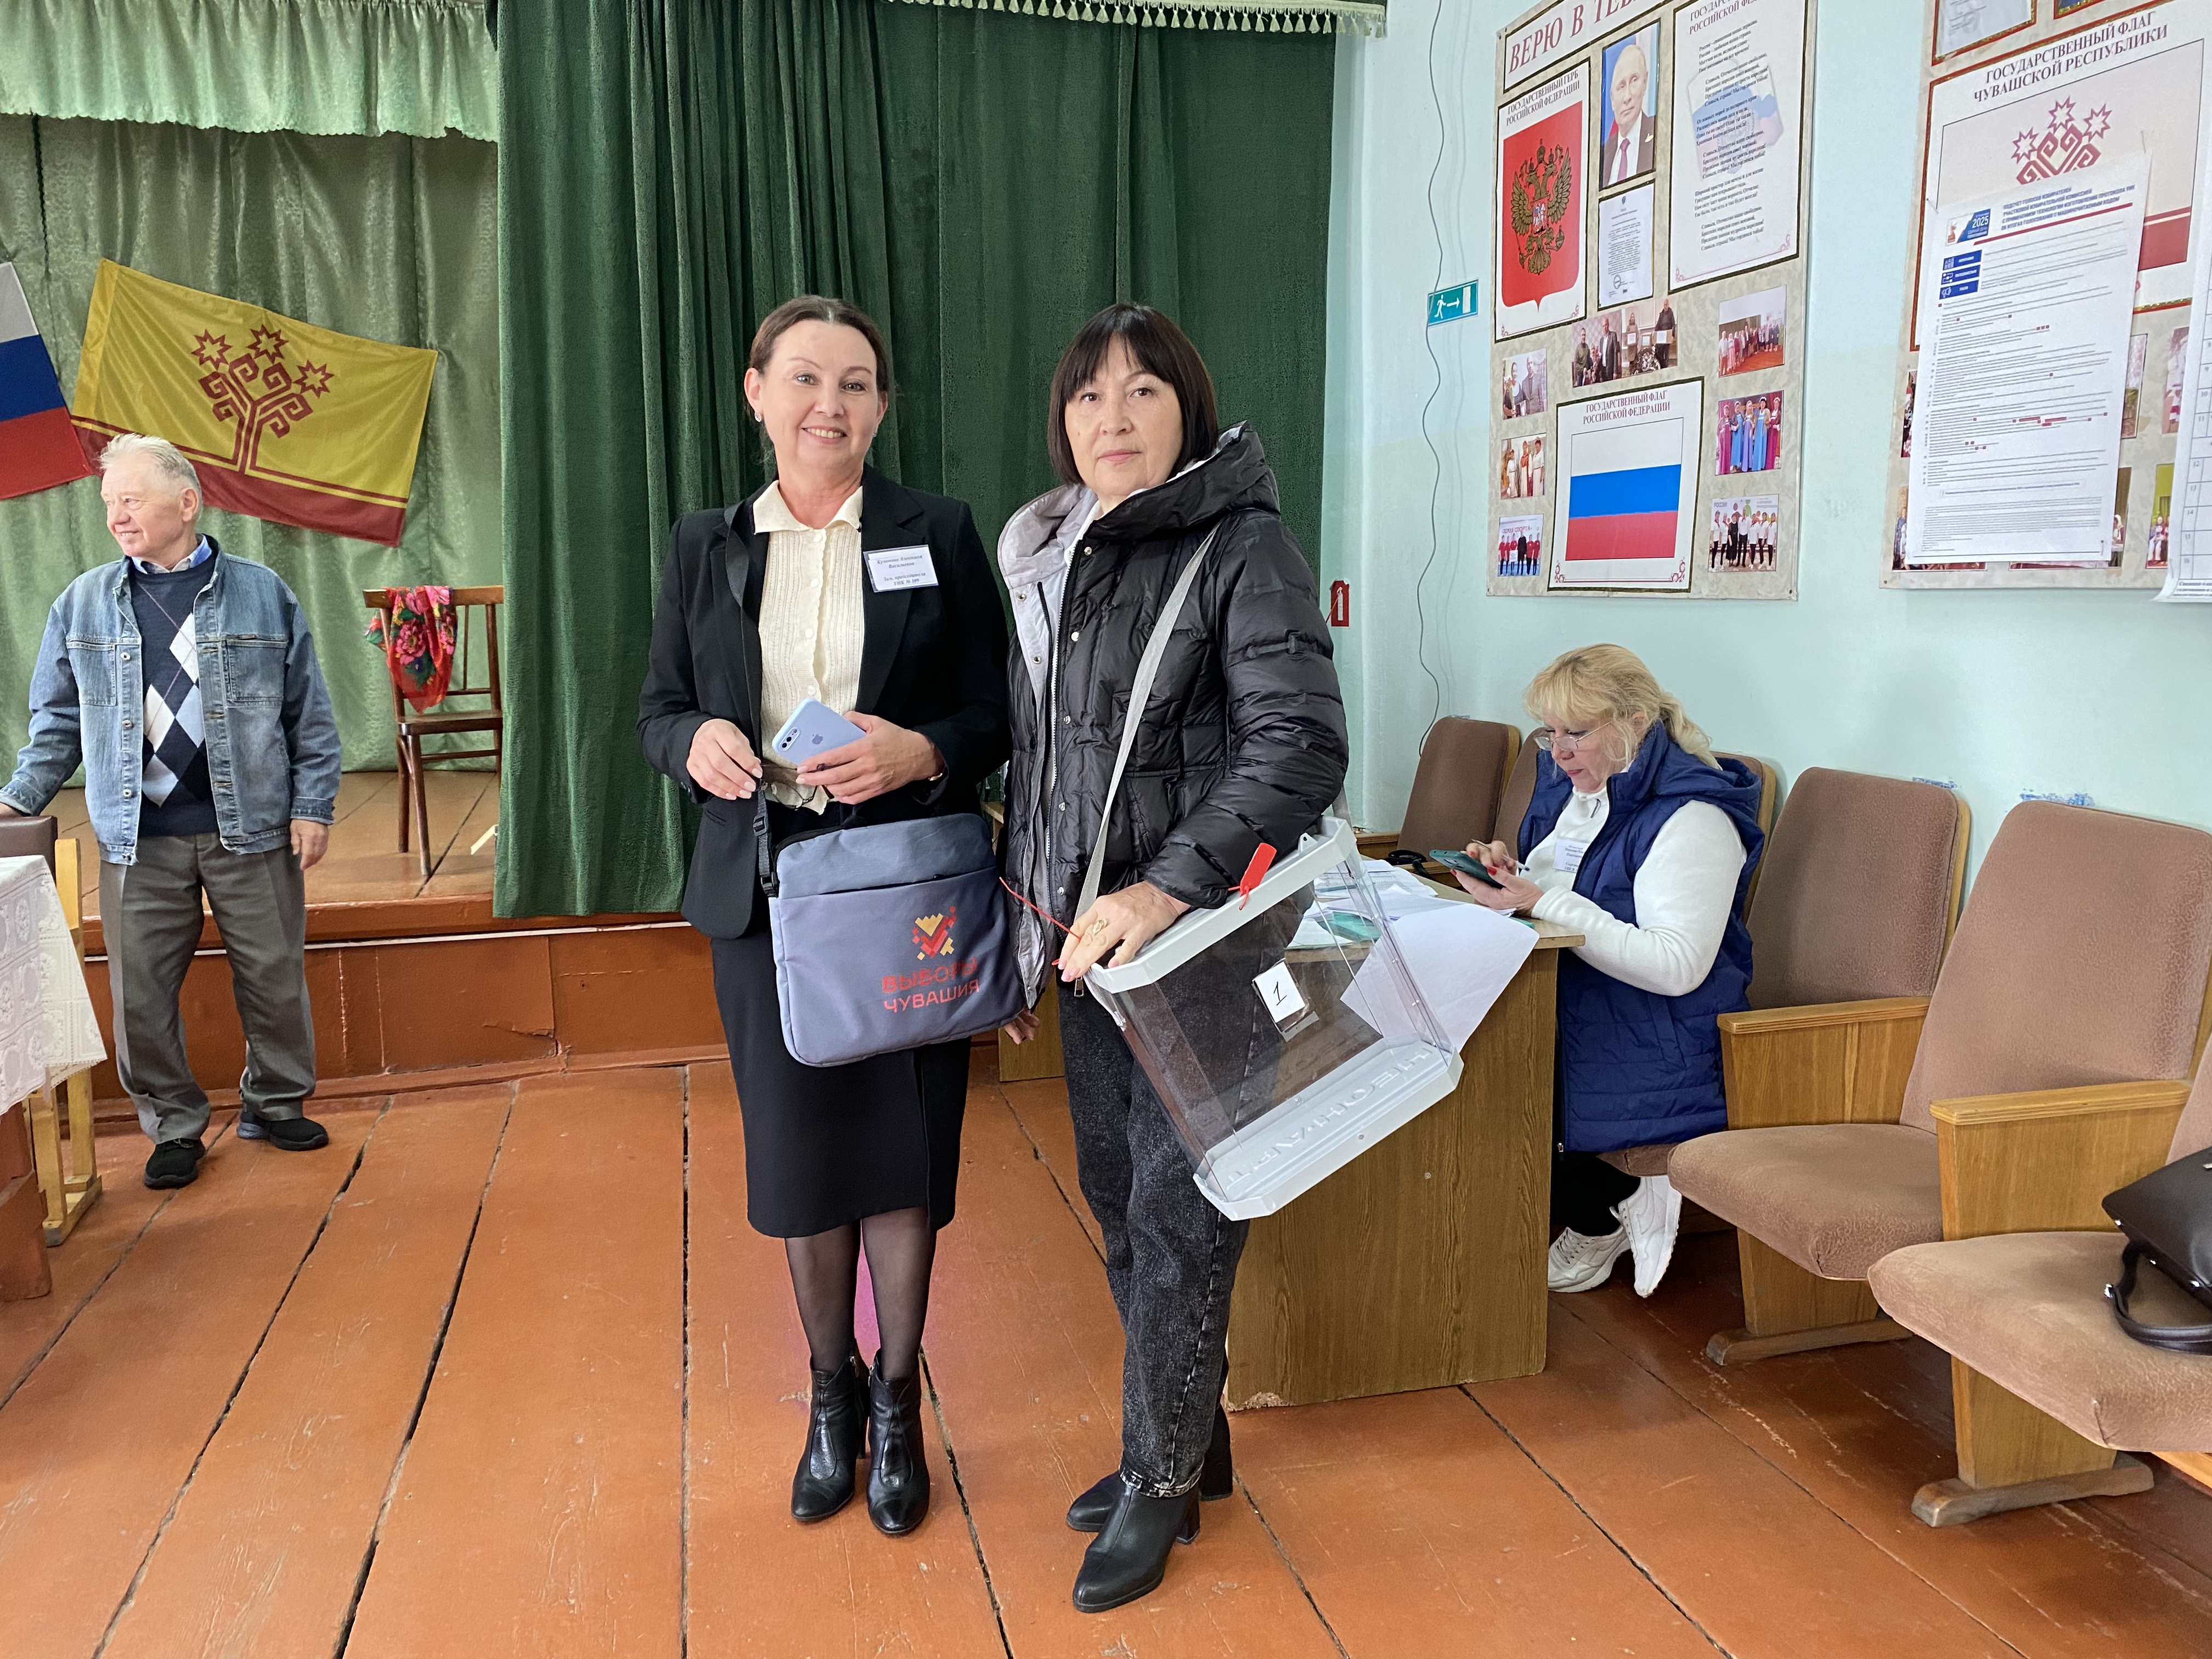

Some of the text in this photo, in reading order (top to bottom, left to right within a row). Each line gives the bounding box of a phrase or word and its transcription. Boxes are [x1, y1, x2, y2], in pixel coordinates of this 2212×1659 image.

[1690, 1, 1739, 35] РОССИЙСКОЙ
[1509, 18, 1562, 74] ВЕРЮ
[1570, 4, 1584, 37] В
[1986, 11, 2156, 84] ГОСУДАРСТВЕННЫЙ ФЛАГ
[1974, 24, 2168, 102] ЧУВАШСКОЙ РЕСПУБЛИКИ
[1506, 80, 1579, 126] РОССИЙСКОЙ ФЕДЕРАЦИИ
[1508, 69, 1578, 115] ГОСУДАРСТВЕННЫЙ ГЕРБ
[1972, 215, 1989, 229] 2025
[1583, 402, 1670, 425] РОССИЙСКОЙ ФЕДЕРАЦИИ
[1586, 390, 1667, 413] ГОСУДАРСТВЕННЫЙ ФЛАГ
[881, 957, 978, 993] ВЫБОРЫ
[883, 979, 980, 1013] ЧУВАШИЯ
[1276, 981, 1288, 1006] 1
